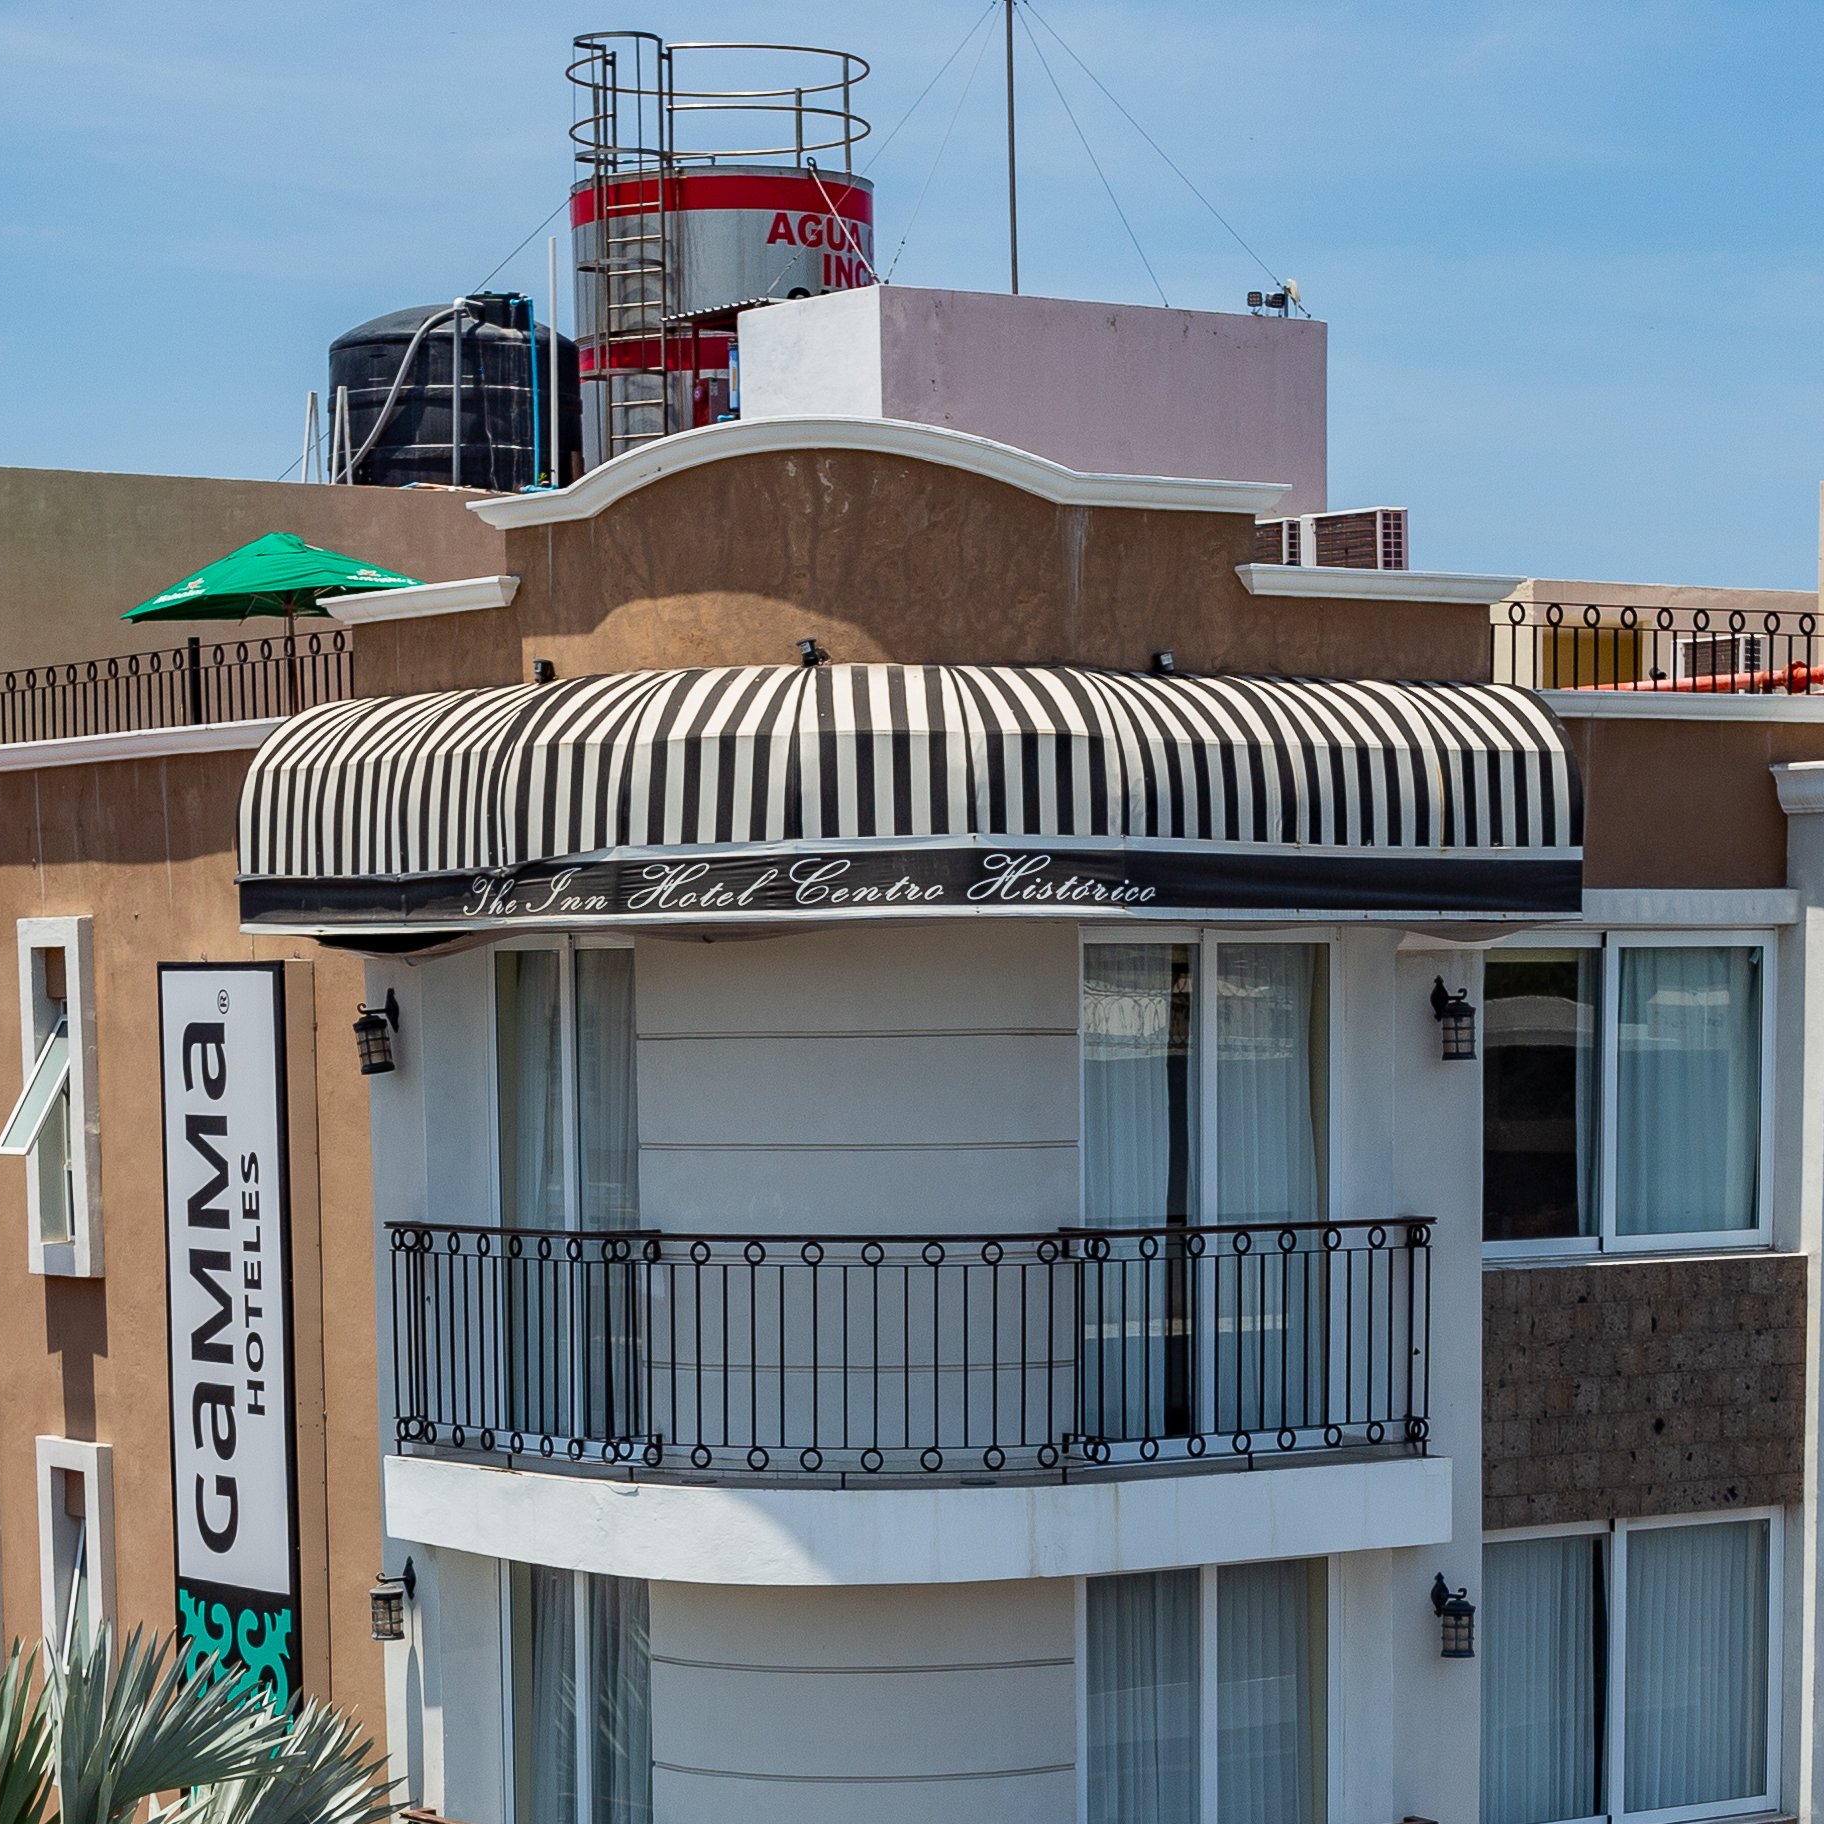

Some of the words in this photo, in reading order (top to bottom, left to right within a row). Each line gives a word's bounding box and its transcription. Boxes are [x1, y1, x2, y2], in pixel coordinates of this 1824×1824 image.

[766, 212, 863, 254] AGUA
[463, 875, 517, 916] The
[526, 867, 608, 914] Inn
[627, 862, 778, 910] Hotel
[789, 857, 945, 905] Centro
[966, 853, 1156, 902] Histórico
[241, 1151, 266, 1417] HOTELES
